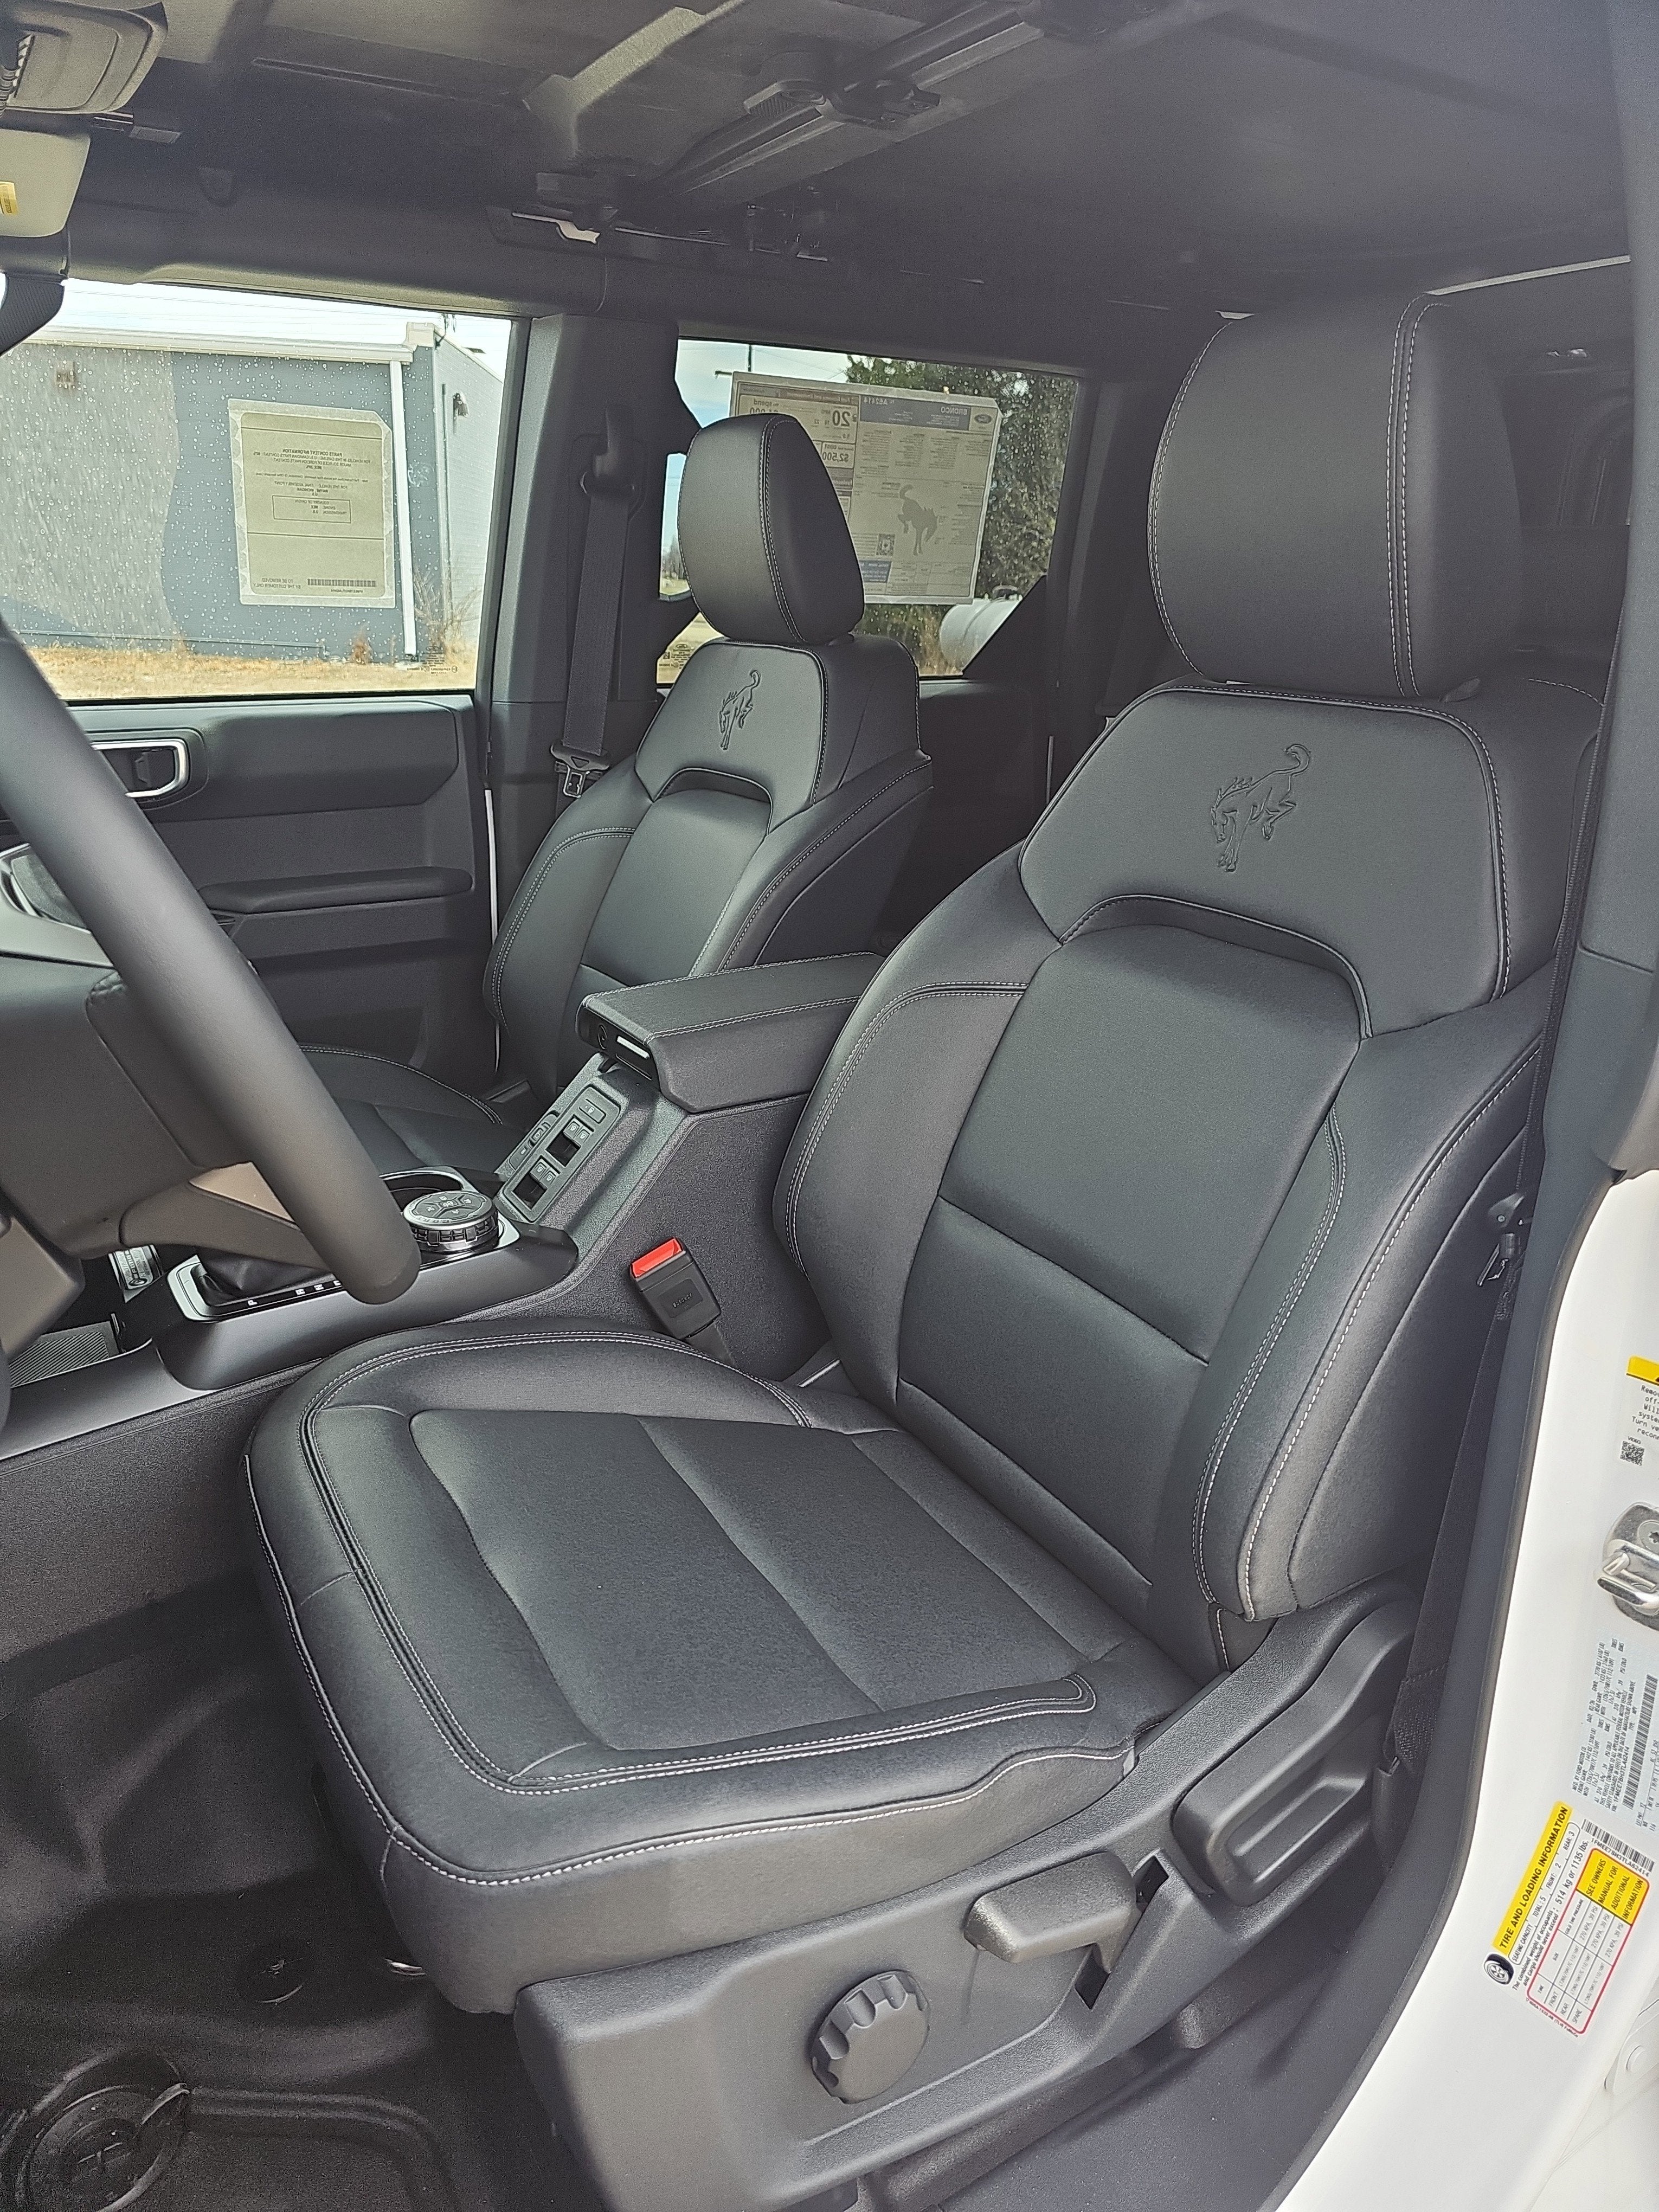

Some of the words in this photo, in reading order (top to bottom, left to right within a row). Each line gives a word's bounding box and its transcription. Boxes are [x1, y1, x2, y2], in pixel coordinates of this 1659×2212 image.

[1632, 1416, 1647, 1427] Turn
[1638, 1411, 1659, 1423] syste
[1602, 1782, 1610, 1797] VEHICLE
[1578, 1838, 1589, 1852] lbs.
[1571, 1850, 1583, 1869] 1135
[1500, 1926, 1514, 1950] TIRE
[1510, 1907, 1523, 1927] AND
[1520, 1867, 1541, 1907] LOADING
[1538, 1806, 1568, 1867] INFORMATION
[1562, 1877, 1572, 1889] kg
[1568, 1869, 1576, 1879] or
[1586, 1883, 1596, 1896] SEE
[1591, 1858, 1606, 1884] OWNERS
[1598, 1878, 1613, 1904] MANUAL
[1608, 1865, 1618, 1879] FOR
[1610, 1874, 1630, 1911] ADDITIONAL
[1555, 1889, 1566, 1905] 514
[1622, 1877, 1643, 1920] INFORMATION
[1512, 1943, 1523, 1962] SEATING
[1520, 1922, 1533, 1945] CAPACITY
[1517, 1956, 1531, 1981] combined
[1528, 1940, 1539, 1958] weight
[1539, 1909, 1553, 1935] occupants
[1527, 1961, 1537, 1977] cargo
[1534, 1944, 1544, 1962] should
[1541, 1930, 1551, 1945] never
[1548, 1990, 1558, 2008] FRONT
[1560, 2002, 1569, 2016] REAR
[1572, 2007, 1582, 2024] SPARE
